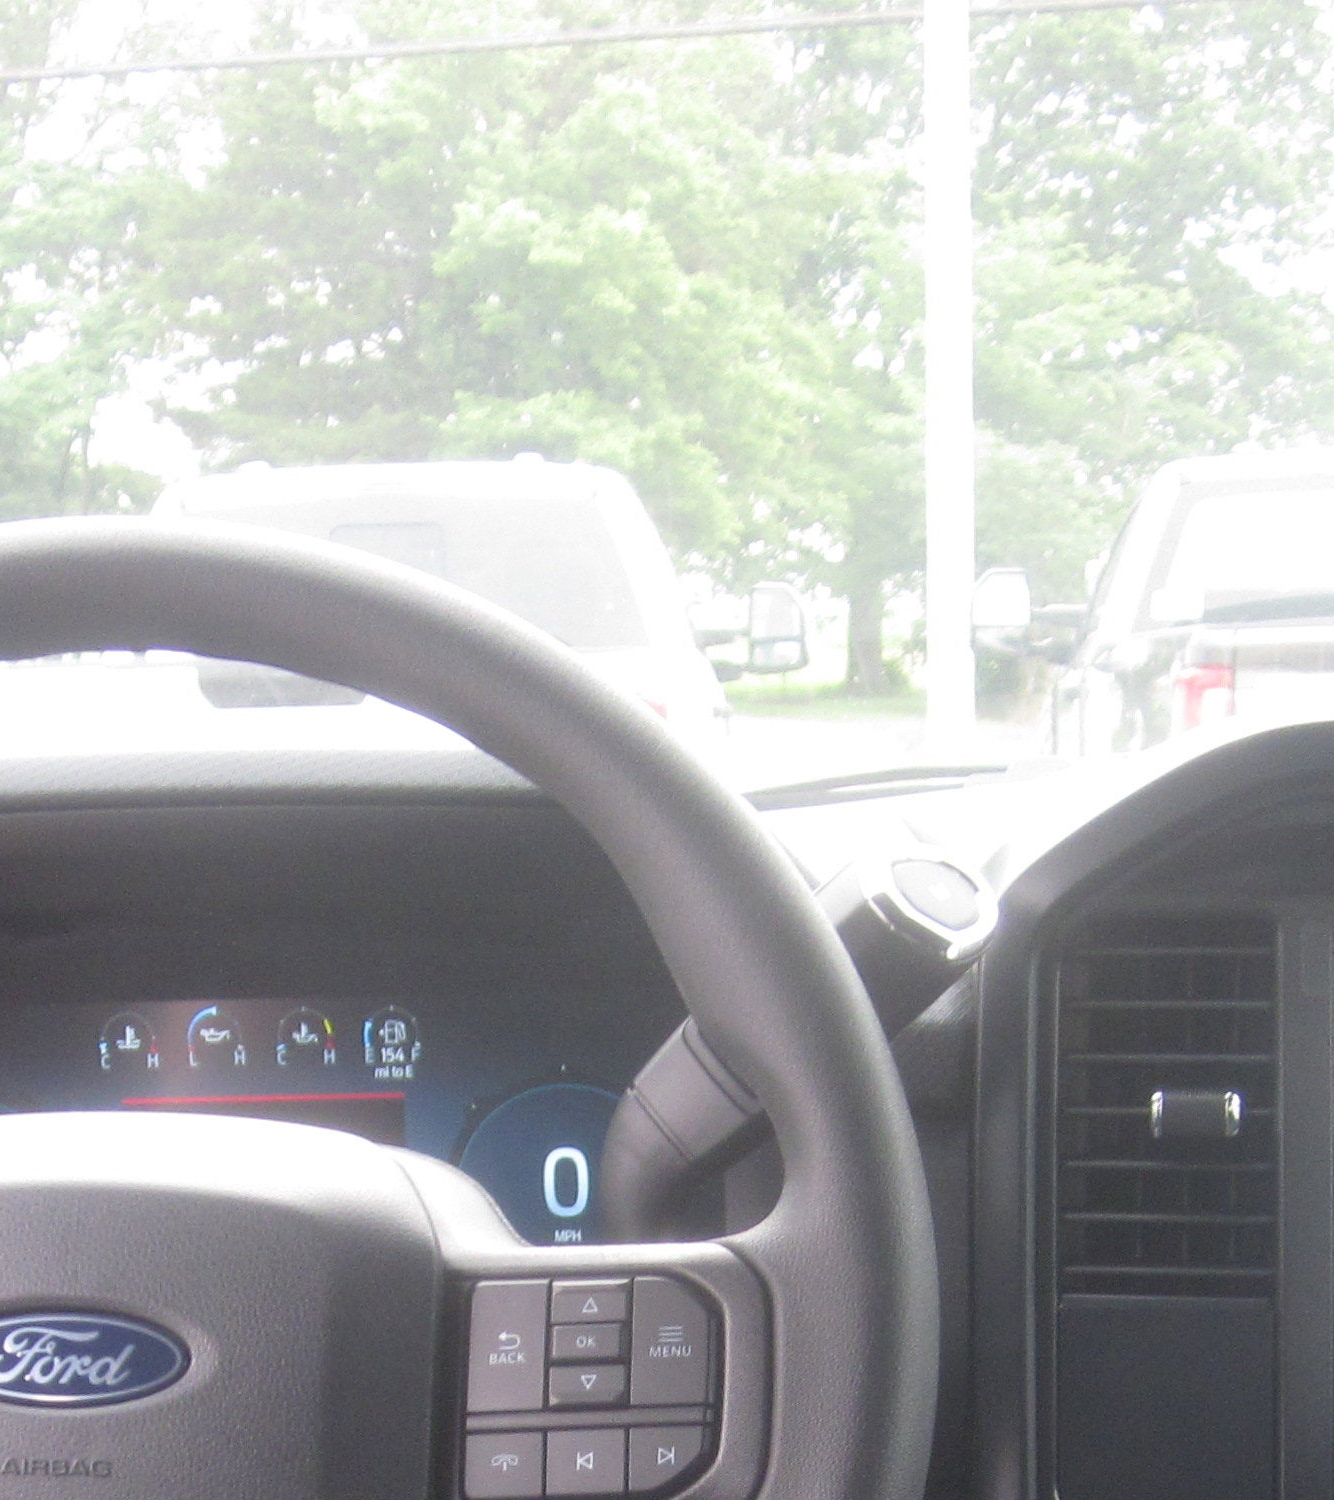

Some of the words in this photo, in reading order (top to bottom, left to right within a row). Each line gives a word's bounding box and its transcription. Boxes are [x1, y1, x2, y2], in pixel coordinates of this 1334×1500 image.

[147, 1053, 159, 1068] H
[189, 1051, 199, 1067] L
[324, 1050, 336, 1064] H
[380, 1047, 405, 1063] 154
[374, 1065, 389, 1078] mi
[391, 1066, 404, 1078] to
[406, 1065, 414, 1078] E
[543, 1146, 589, 1217] 0
[554, 1229, 582, 1242] MPH
[575, 1335, 596, 1347] OK
[489, 1352, 526, 1365] BACK
[649, 1345, 692, 1358] MENU
[0, 1458, 113, 1478] AIRBAG
